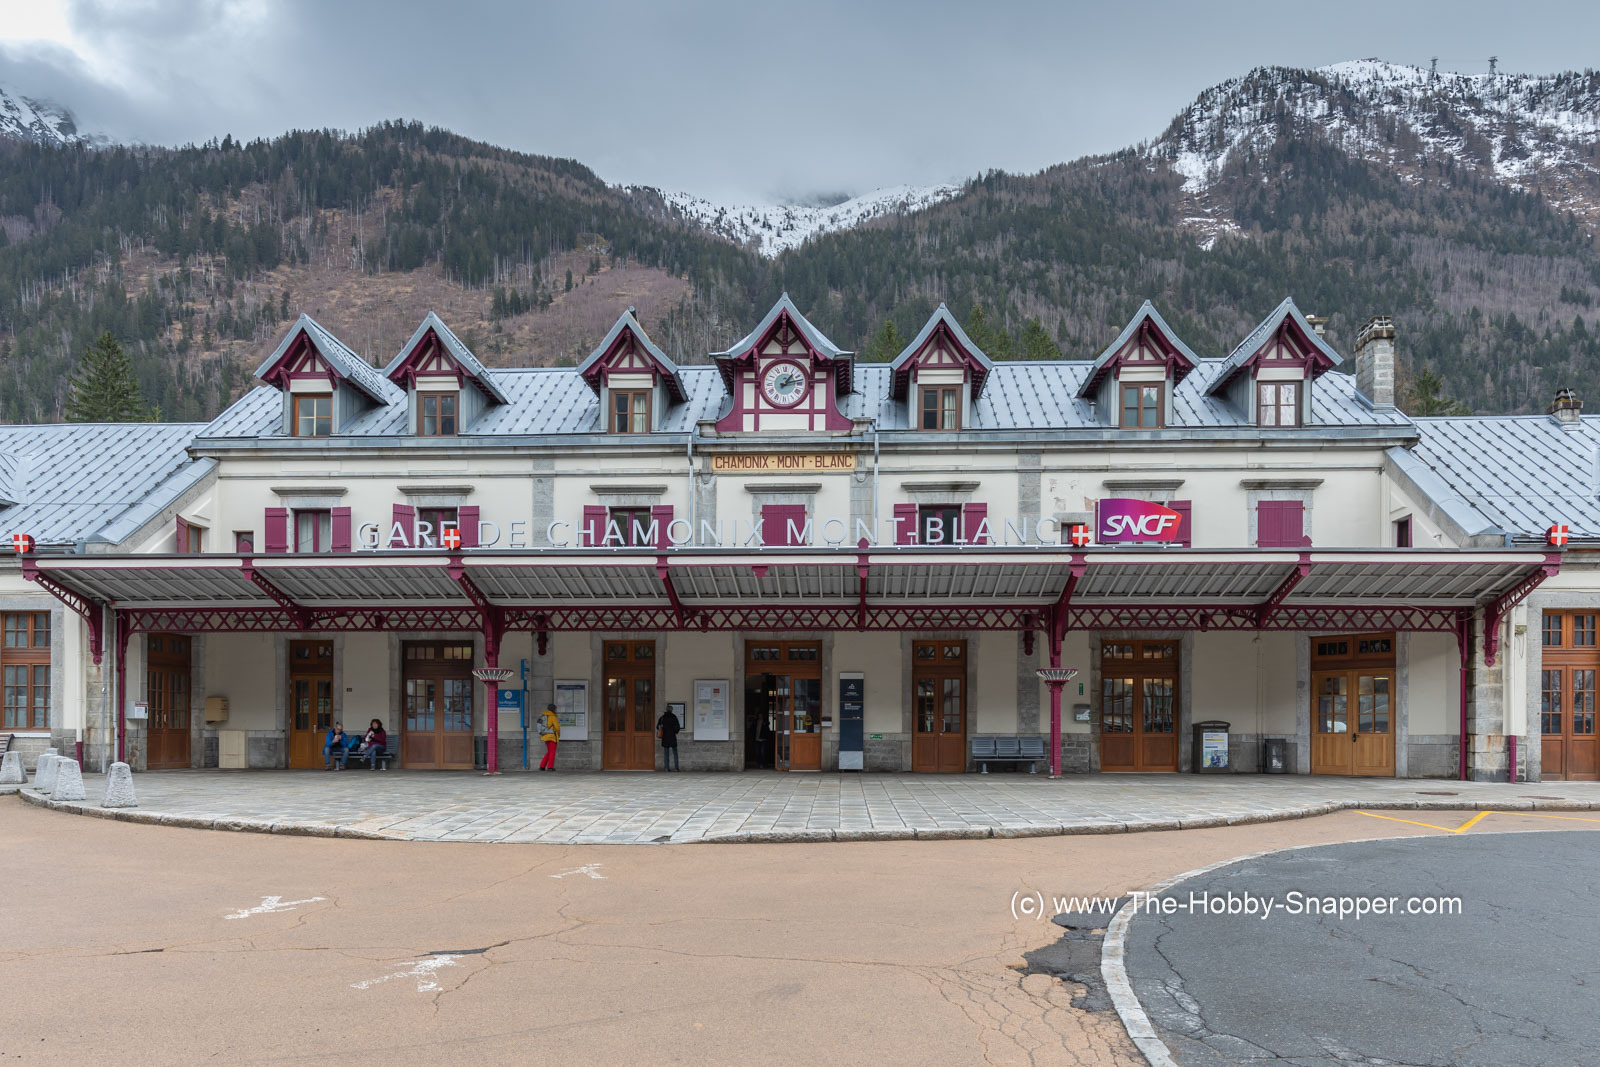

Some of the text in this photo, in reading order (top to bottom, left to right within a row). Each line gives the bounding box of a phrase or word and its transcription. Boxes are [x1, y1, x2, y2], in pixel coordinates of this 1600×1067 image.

[715, 455, 852, 468] CHAMONIX MONT BLANC
[478, 520, 526, 546] DE
[546, 519, 766, 546] CHAMONIX
[1102, 515, 1176, 536] SNCF
